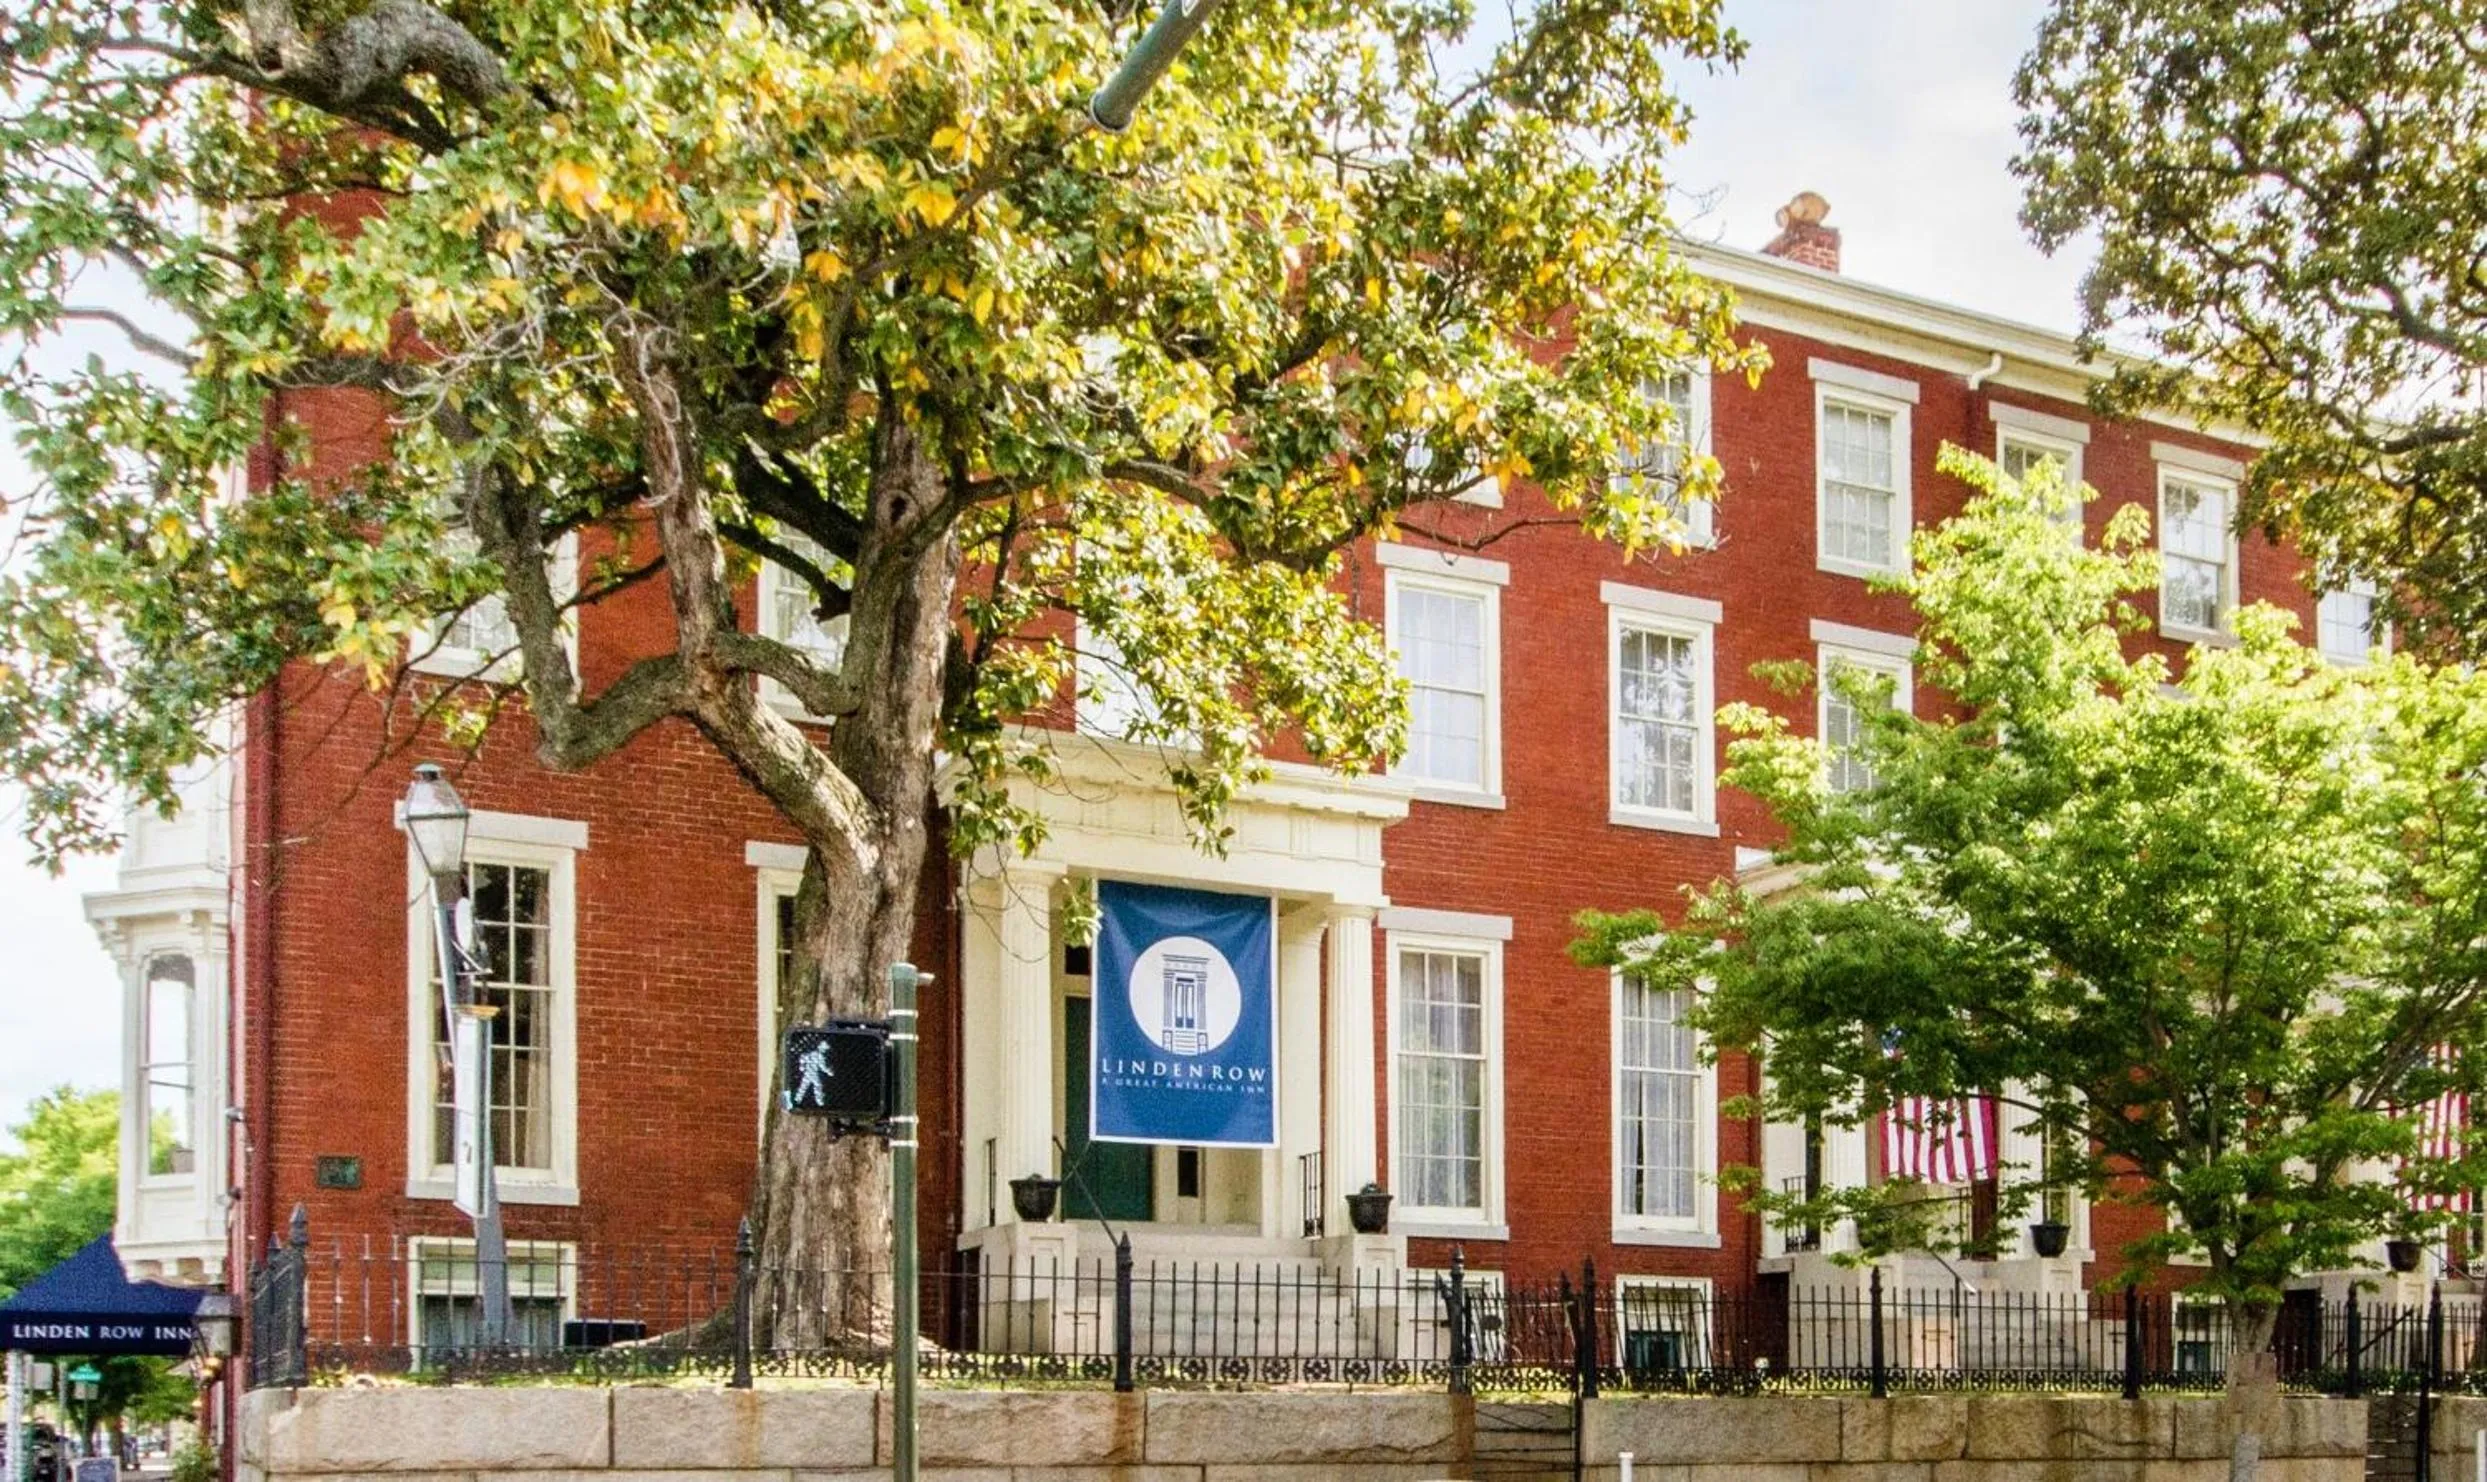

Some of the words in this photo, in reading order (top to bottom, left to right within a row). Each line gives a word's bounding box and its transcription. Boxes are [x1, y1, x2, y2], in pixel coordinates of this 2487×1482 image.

[1114, 1078, 1158, 1089] GREAT
[1165, 1081, 1233, 1093] AMERICAN
[1240, 1085, 1266, 1094] INN
[12, 1324, 91, 1339] LINDEN
[99, 1325, 145, 1340] ROW
[154, 1326, 193, 1341] INN
